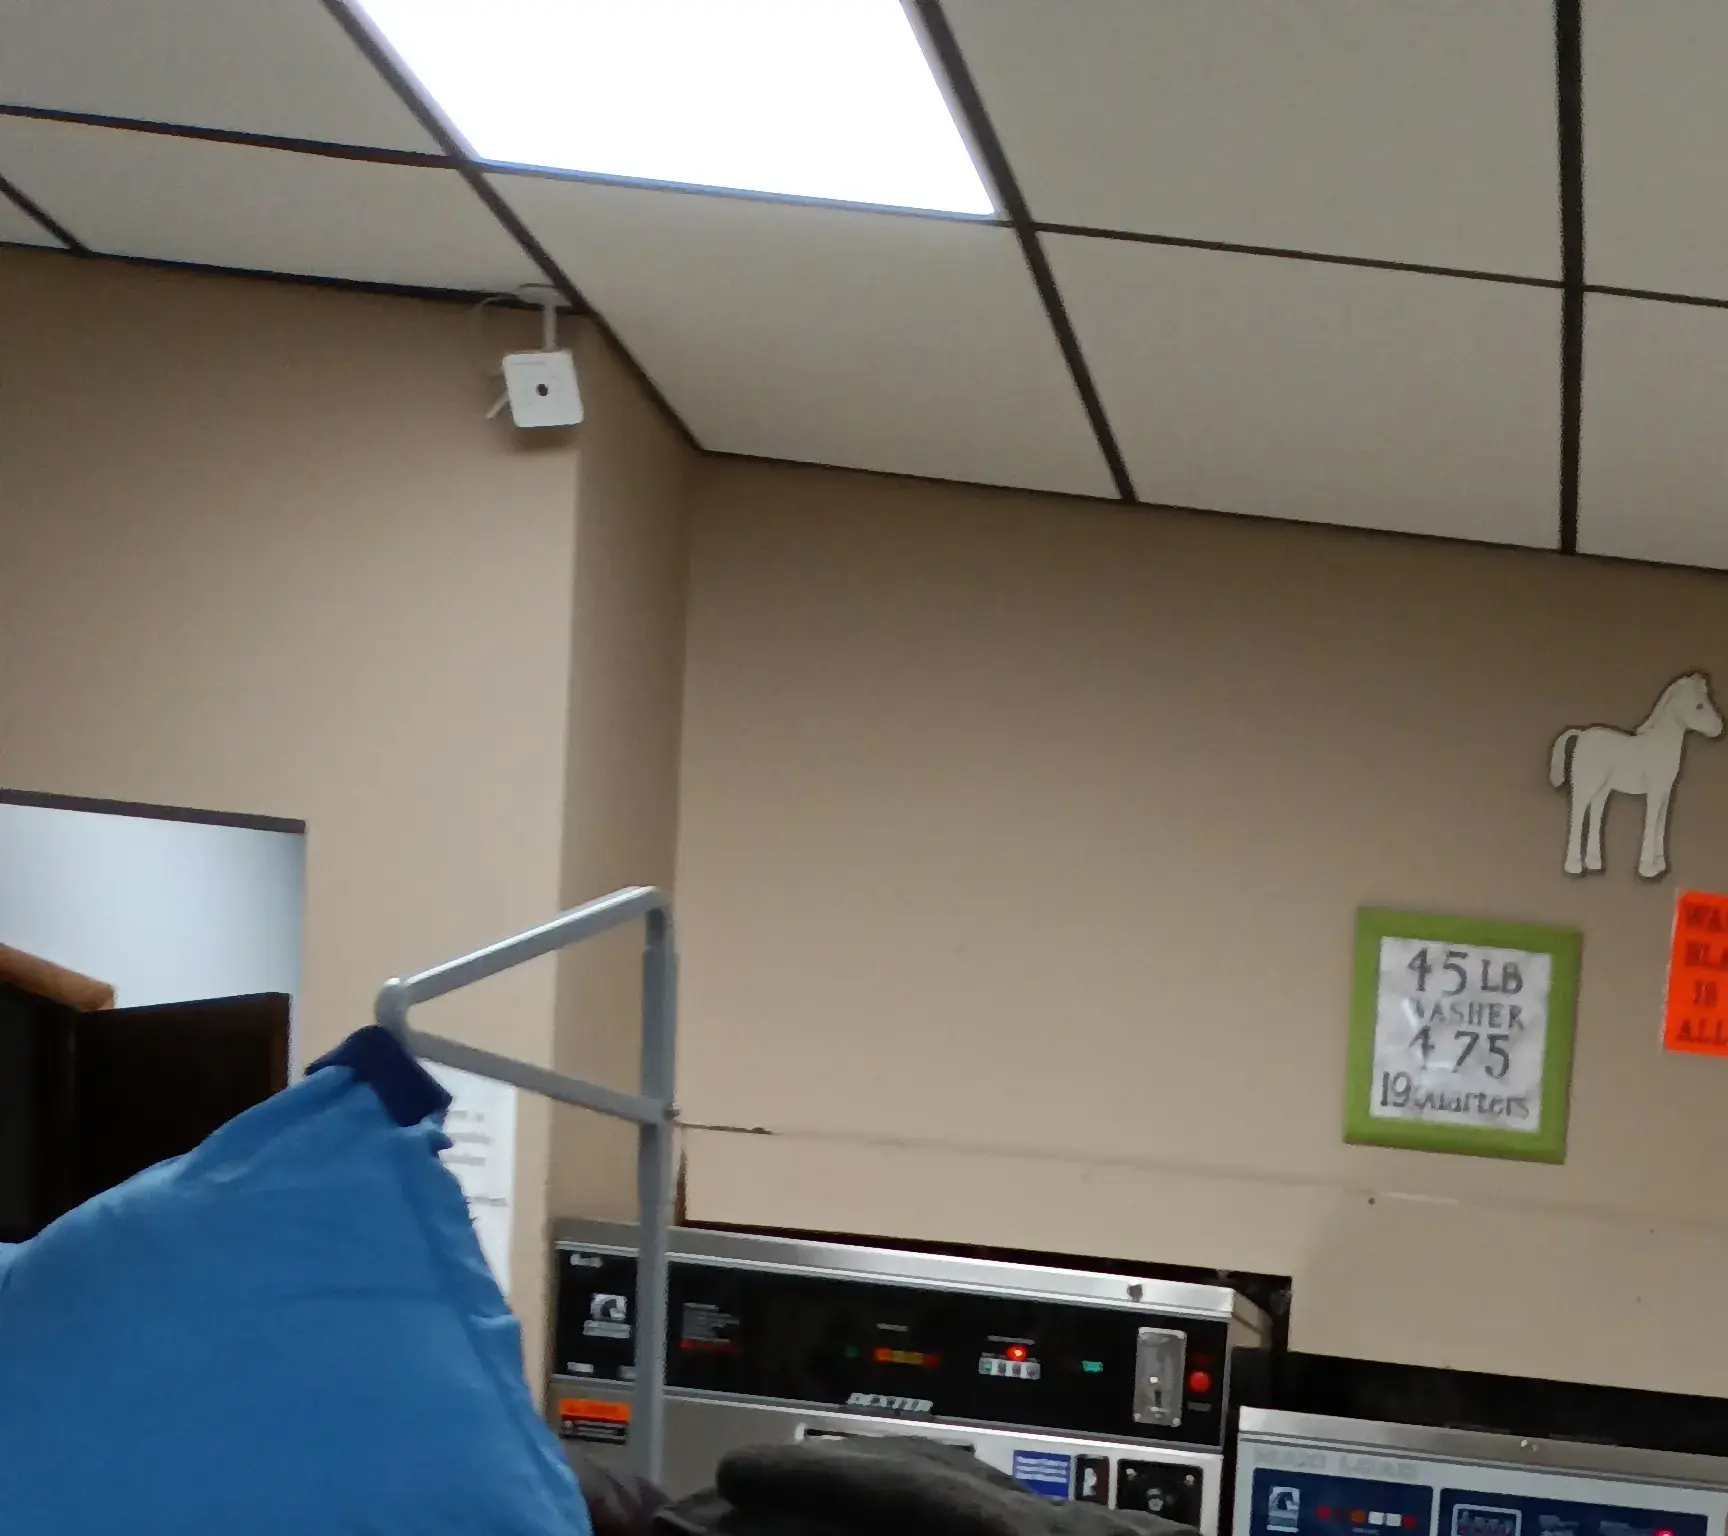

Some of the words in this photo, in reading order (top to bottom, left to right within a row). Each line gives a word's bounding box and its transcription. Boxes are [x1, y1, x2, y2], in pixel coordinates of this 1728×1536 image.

[1407, 947, 1469, 996] 45
[1481, 958, 1523, 995] LB
[1693, 981, 1717, 1007] IS
